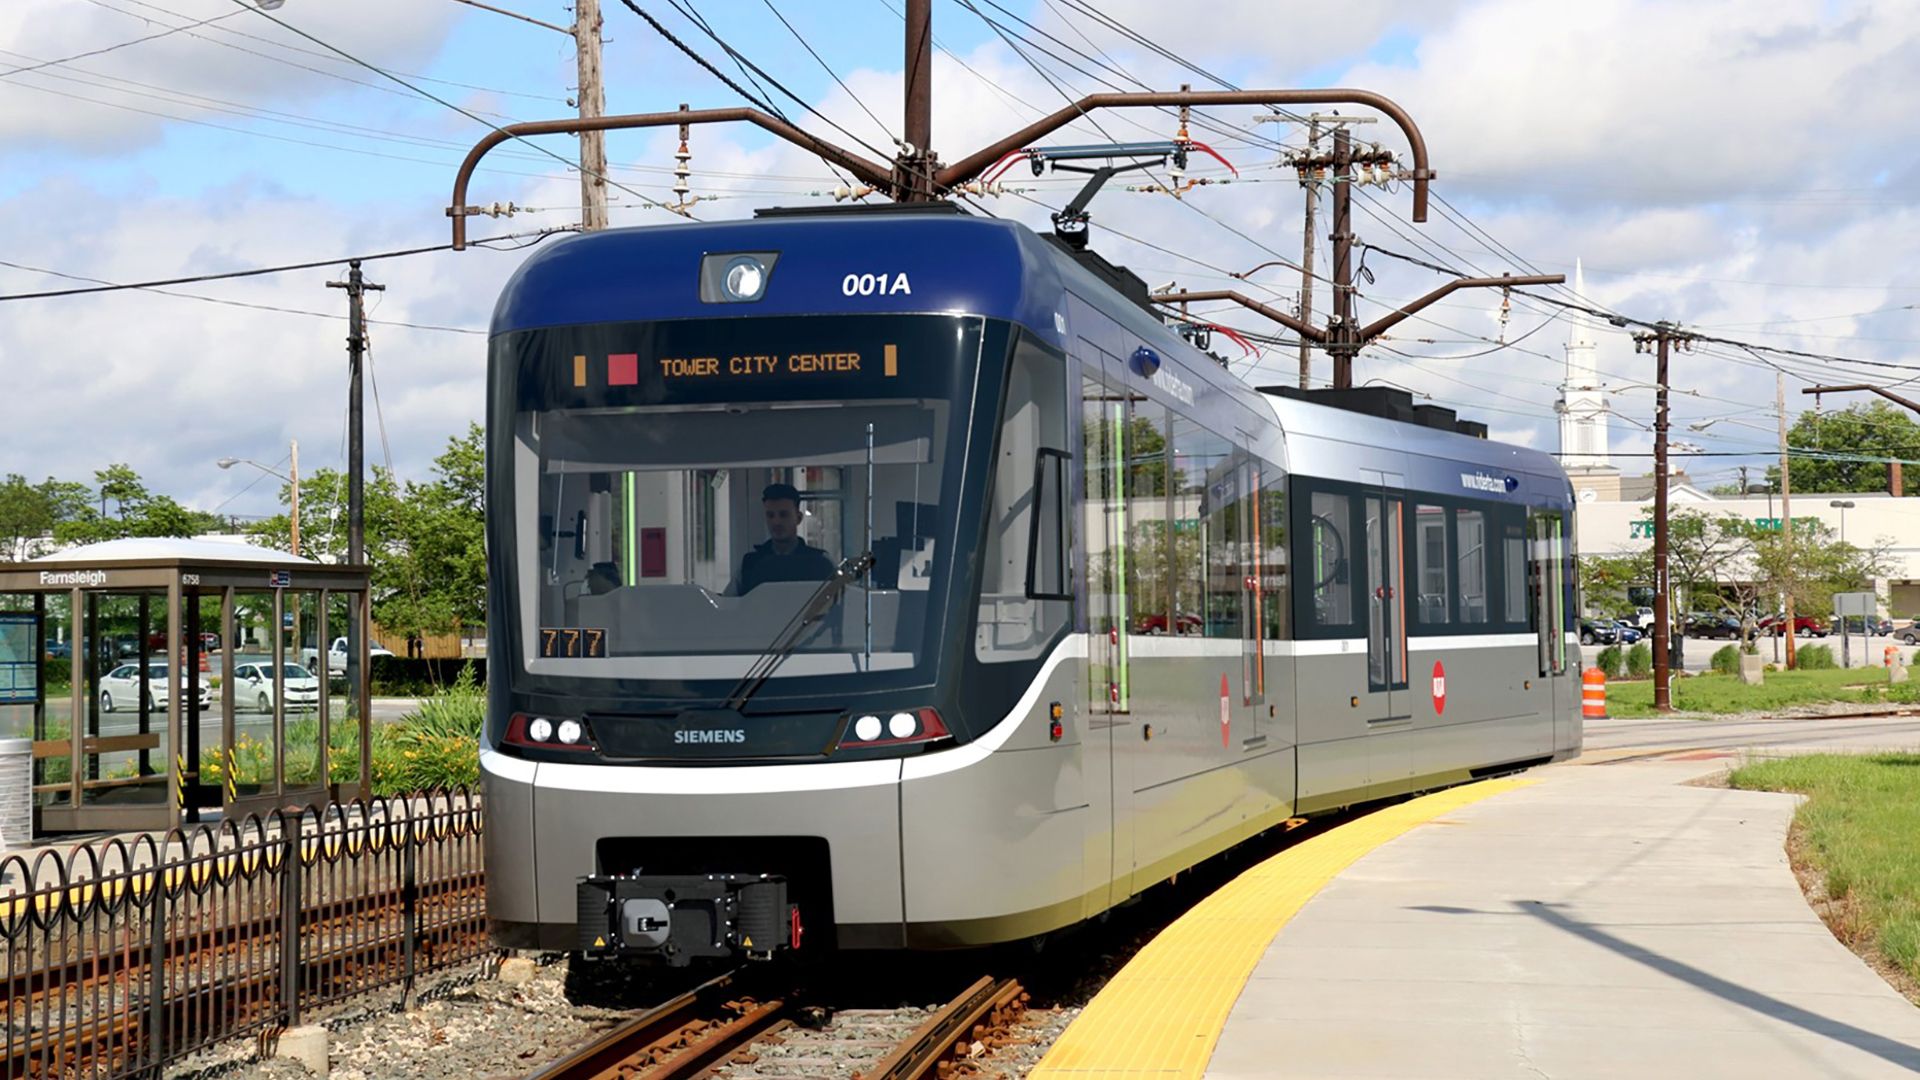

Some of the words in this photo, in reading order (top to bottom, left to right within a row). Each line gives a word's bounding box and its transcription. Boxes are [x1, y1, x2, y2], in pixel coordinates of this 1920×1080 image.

[842, 272, 912, 296] 001A
[660, 358, 719, 377] TOWER
[729, 355, 778, 375] CITY
[788, 352, 861, 372] CENTER
[40, 570, 107, 586] Farnsleigh
[674, 729, 746, 744] SIEMENS
